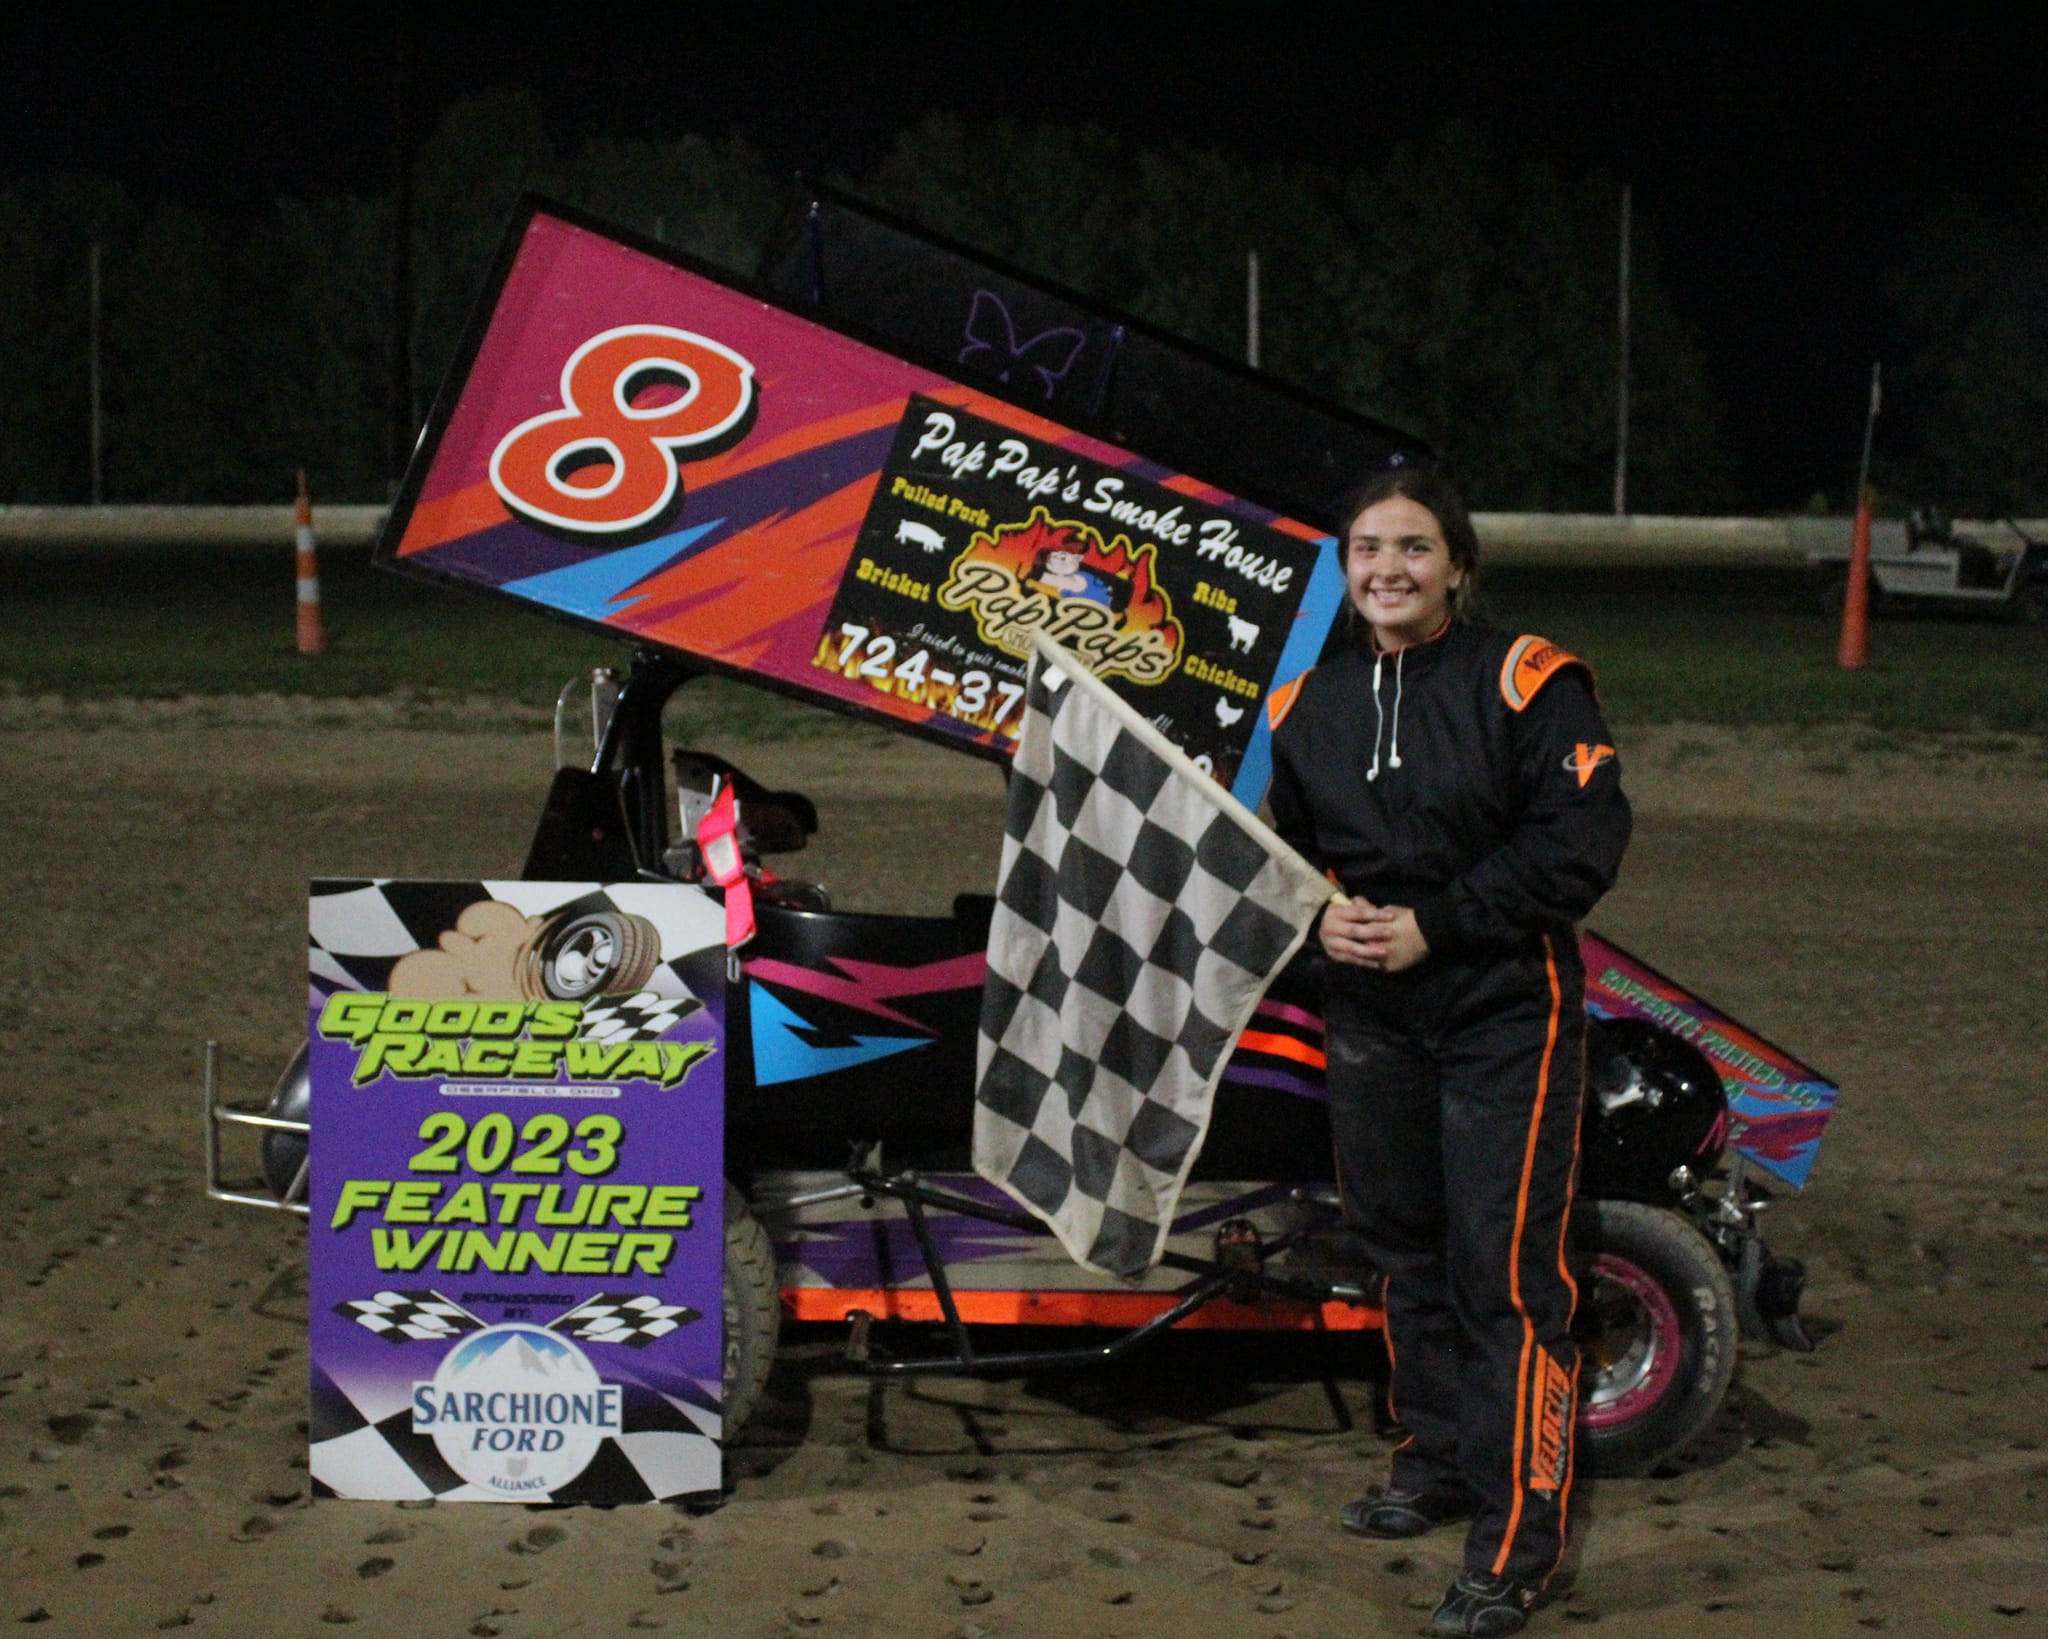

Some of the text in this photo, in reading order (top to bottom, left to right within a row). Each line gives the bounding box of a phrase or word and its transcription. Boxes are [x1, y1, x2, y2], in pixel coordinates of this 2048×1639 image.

[490, 324, 757, 536] 8
[891, 476, 991, 529] Pulled Pork
[910, 412, 1293, 593] Pap Pap's Smoke House
[855, 557, 932, 602] Brisket
[1191, 581, 1238, 615] Ribs
[948, 563, 1168, 676] Pap Pap's
[837, 621, 1027, 729] 724-37
[951, 644, 967, 657] to
[965, 649, 993, 668] quit
[1183, 654, 1260, 700] Chicken
[318, 992, 585, 1047] GOOD'S
[353, 1031, 717, 1089] RACEWAY
[408, 1112, 624, 1175] 2023
[331, 1180, 700, 1229] FEATURE
[371, 1228, 675, 1275] WINNER
[413, 1385, 619, 1428] SARCHIONE
[471, 1428, 565, 1453] FORD
[487, 1475, 548, 1493] ALLIANCE
